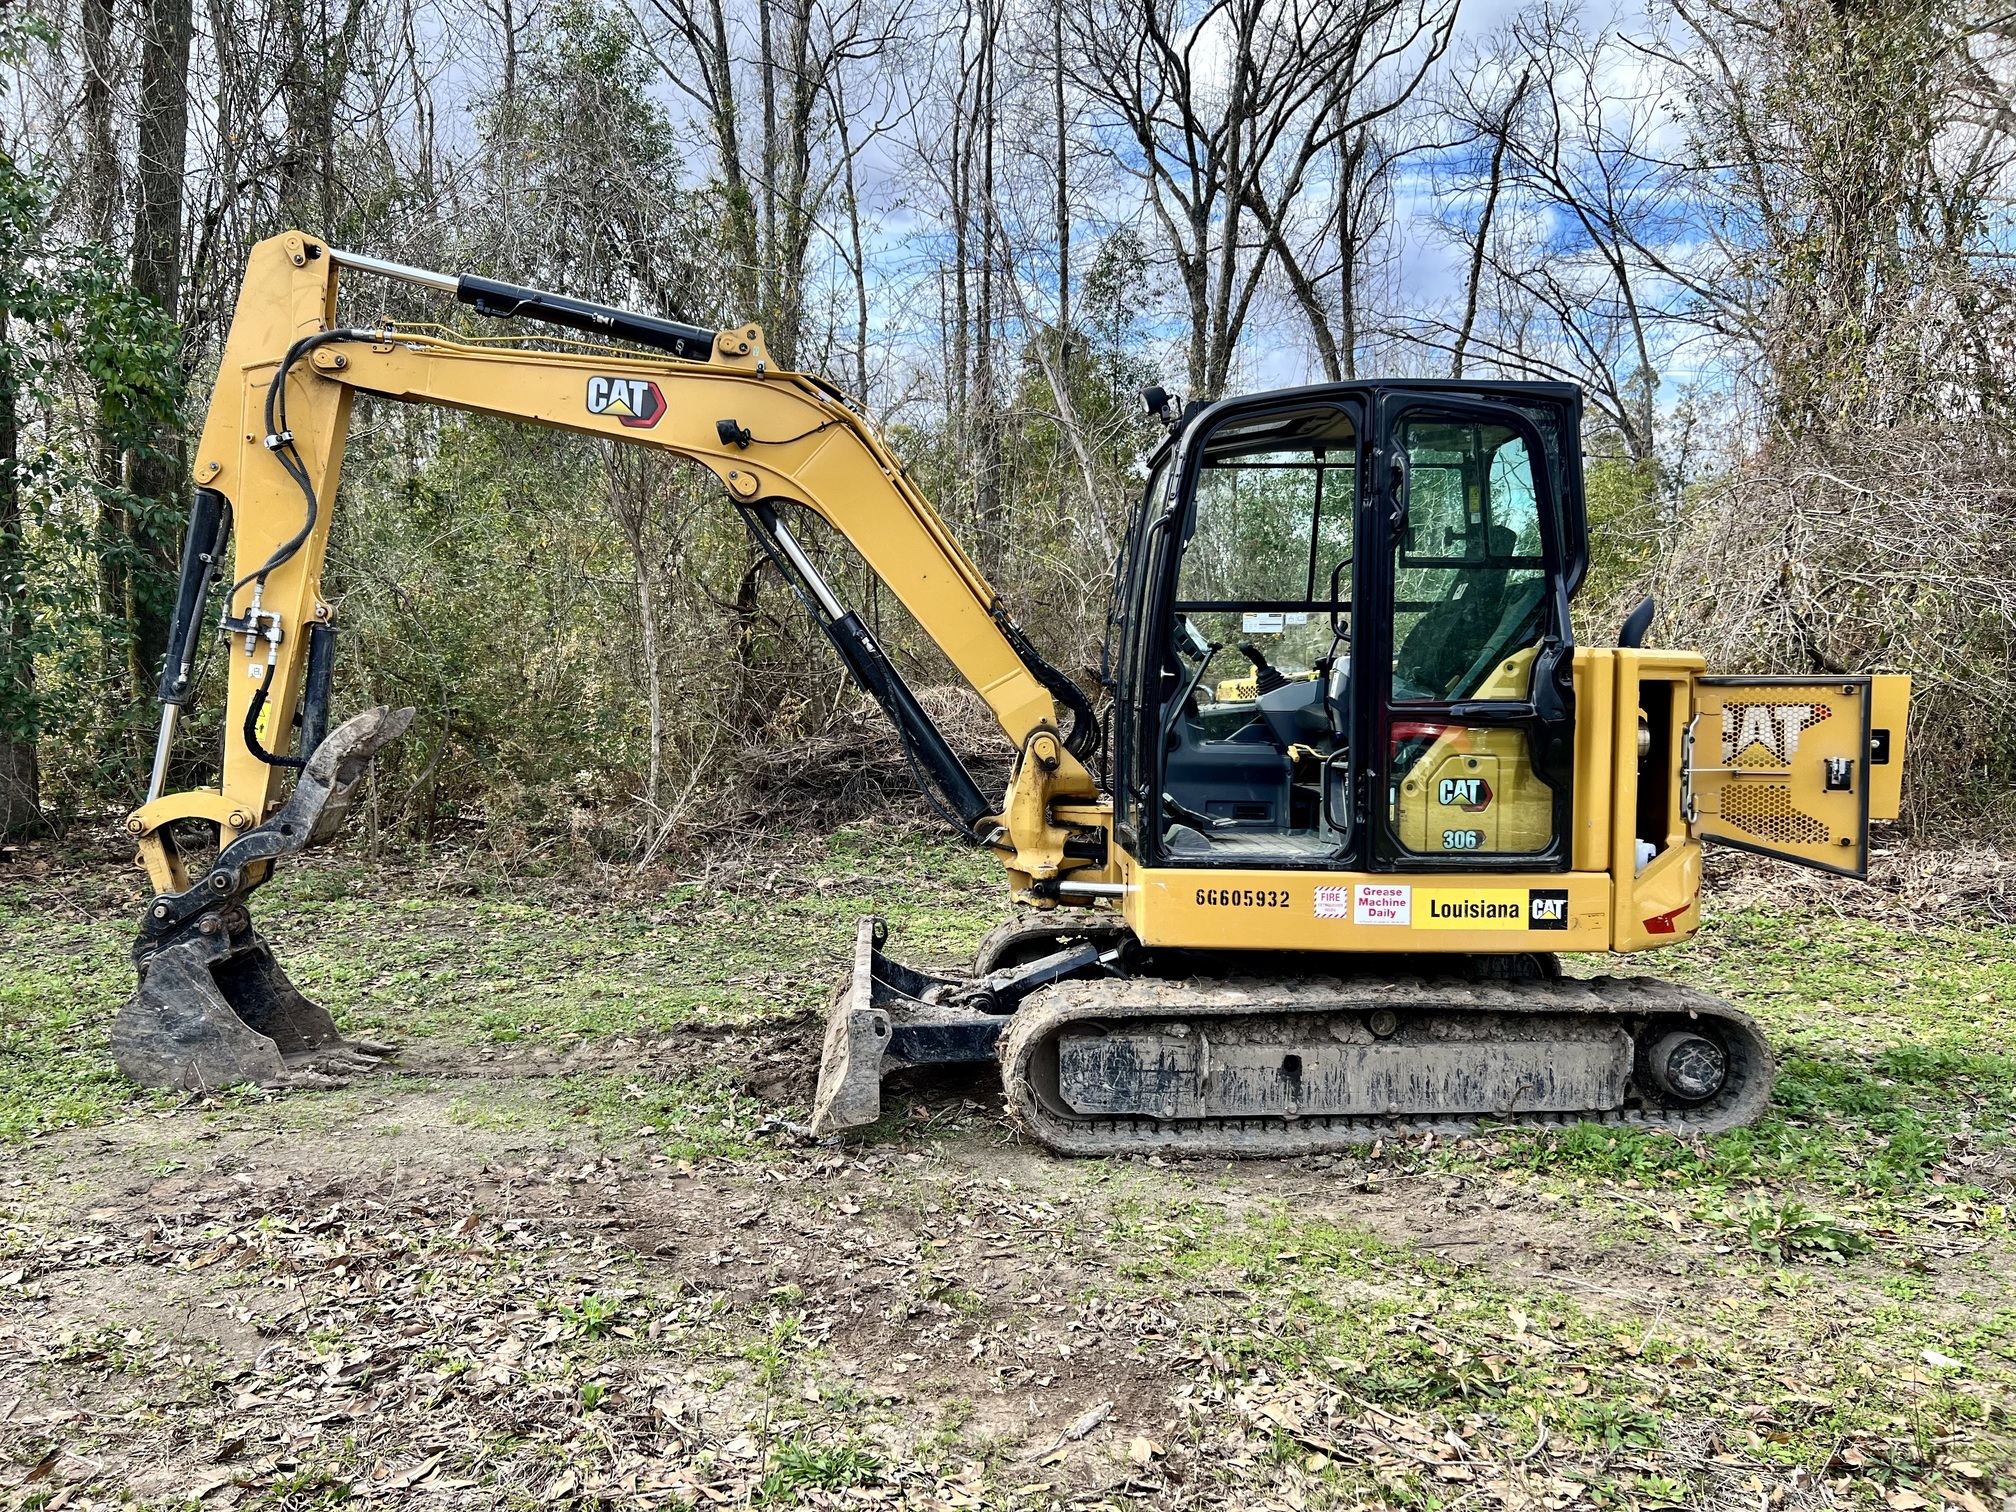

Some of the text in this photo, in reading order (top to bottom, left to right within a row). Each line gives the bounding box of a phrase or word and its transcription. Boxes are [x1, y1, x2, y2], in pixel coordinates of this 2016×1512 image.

[588, 377, 648, 417] CAT
[1440, 779, 1480, 805] CAT
[1443, 830, 1476, 849] 306
[1196, 889, 1290, 907] 6G605932
[1320, 893, 1341, 902] FIRE
[1363, 887, 1403, 897] Grease
[1359, 898, 1407, 907] Machine
[1431, 899, 1567, 919] Louisiana CAT
[1368, 908, 1397, 919] Daily
